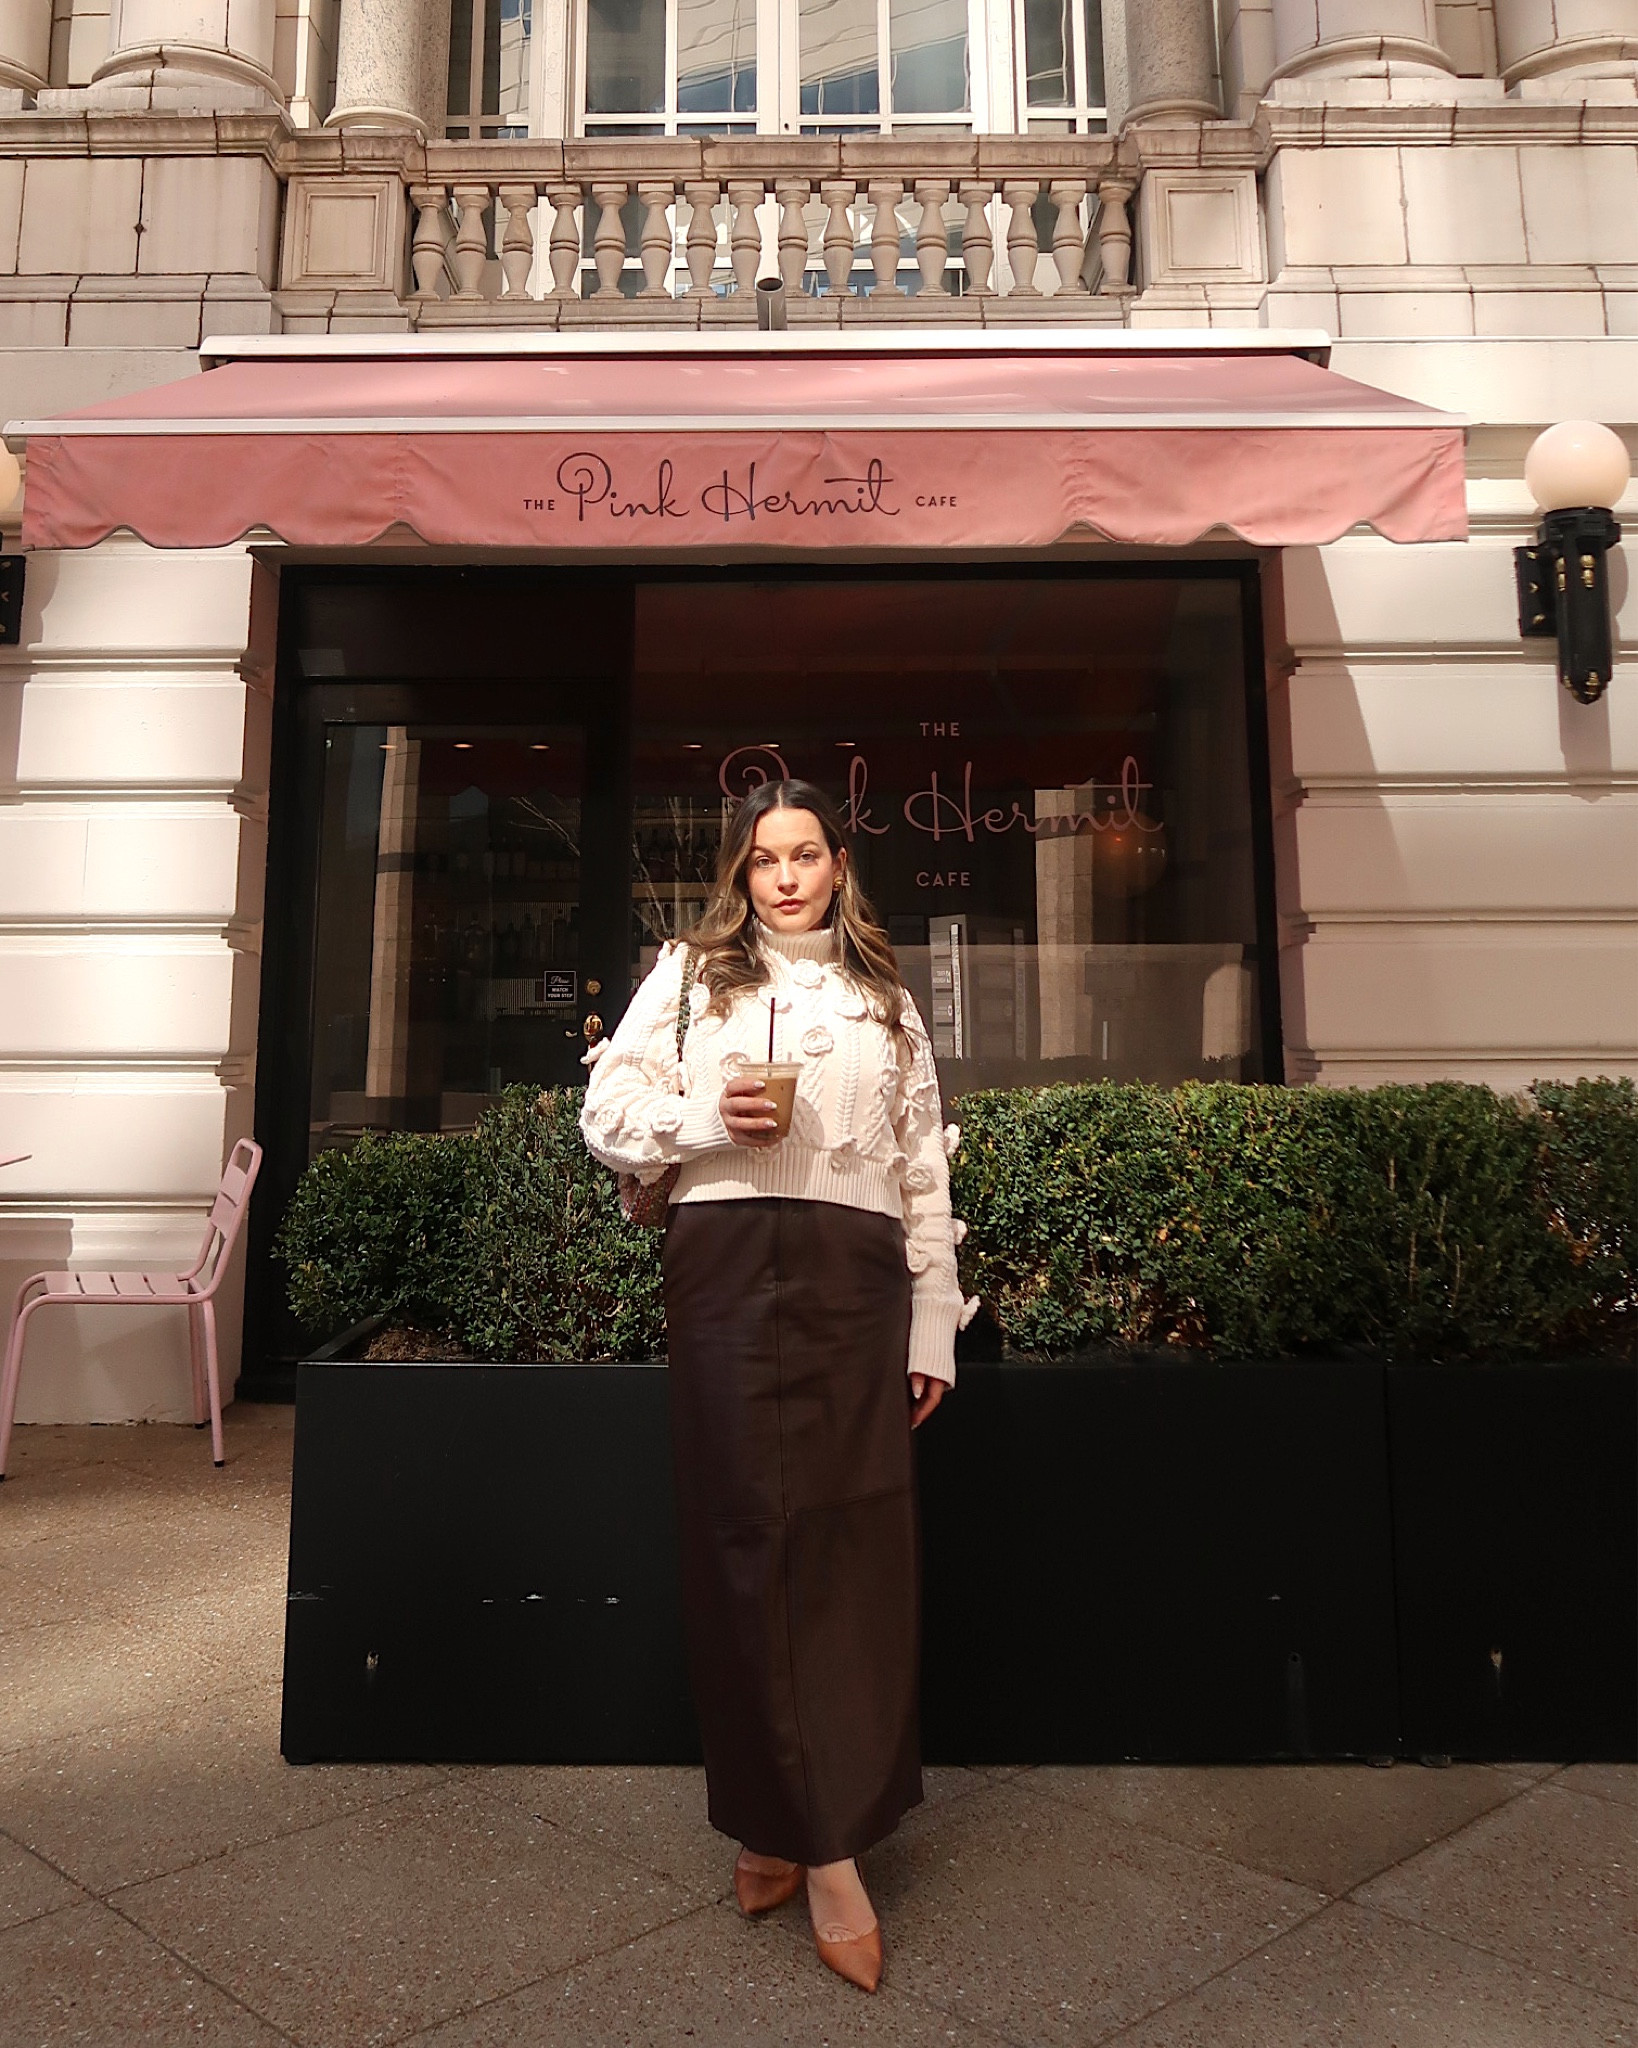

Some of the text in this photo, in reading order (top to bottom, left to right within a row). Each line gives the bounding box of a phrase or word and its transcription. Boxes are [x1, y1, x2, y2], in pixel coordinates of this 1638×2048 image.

[523, 452, 958, 522] THE Pink Hermit CAFE
[919, 722, 960, 737] THE
[719, 746, 1164, 842] Pk Hermit
[916, 871, 971, 887] CAFE
